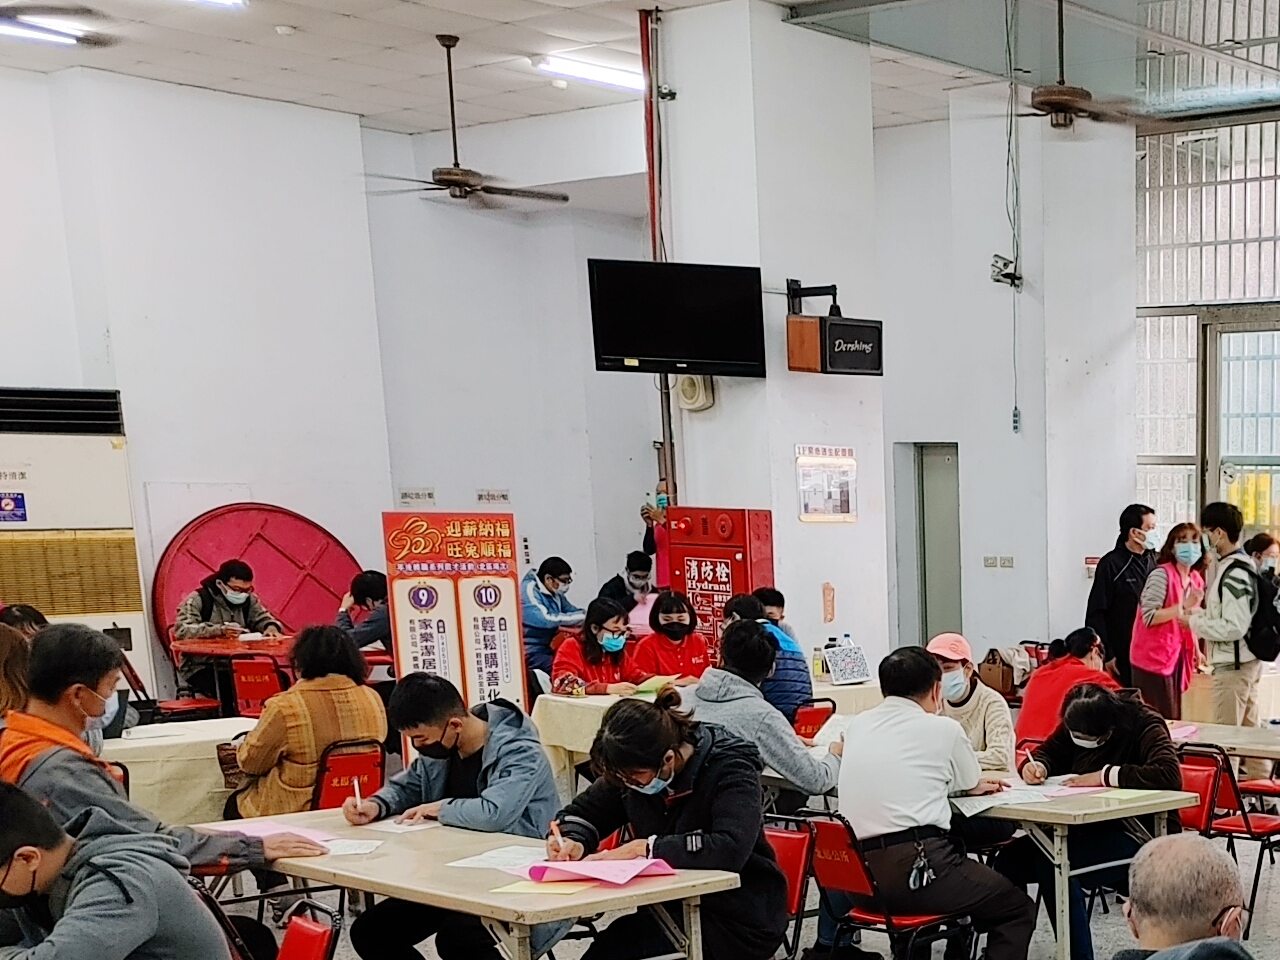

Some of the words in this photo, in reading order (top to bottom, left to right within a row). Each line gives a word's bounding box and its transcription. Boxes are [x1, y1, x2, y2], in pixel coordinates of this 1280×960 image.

[445, 520, 510, 538] 迎薪納福
[446, 541, 512, 558] 旺兔順福
[686, 560, 730, 582] 消防栓
[688, 580, 731, 591] Hydrant
[418, 589, 428, 605] 9
[480, 587, 496, 603] 10
